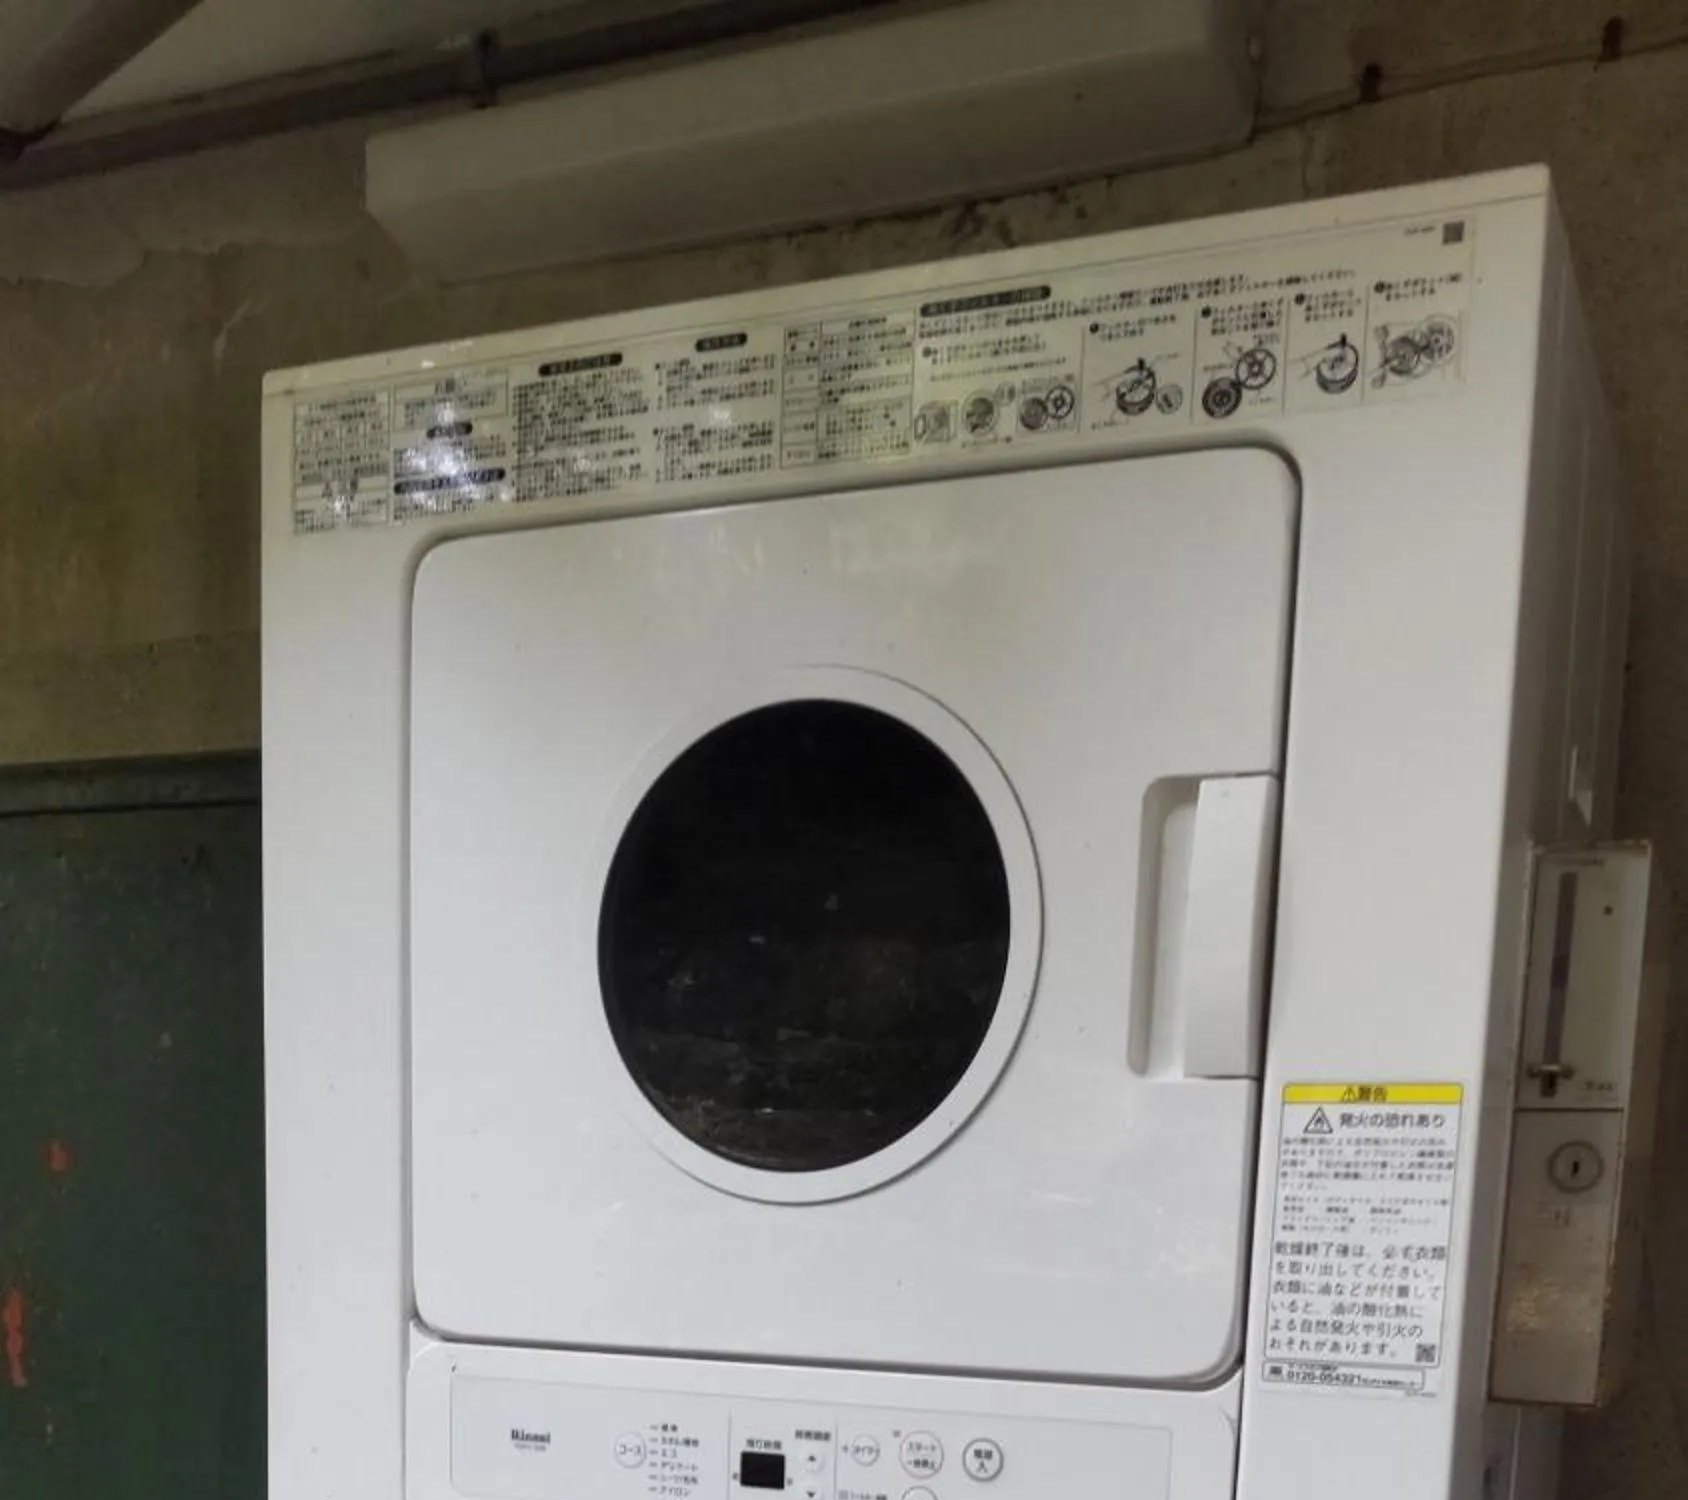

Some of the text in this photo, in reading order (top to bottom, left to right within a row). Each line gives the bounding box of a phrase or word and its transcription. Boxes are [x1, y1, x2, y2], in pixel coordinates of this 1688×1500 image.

[1358, 1086, 1388, 1102] 警告
[1339, 1111, 1446, 1129] 発火の恐れあり
[1270, 1318, 1423, 1338] よる自然発火や引火の
[1269, 1336, 1396, 1358] おそれがあります。
